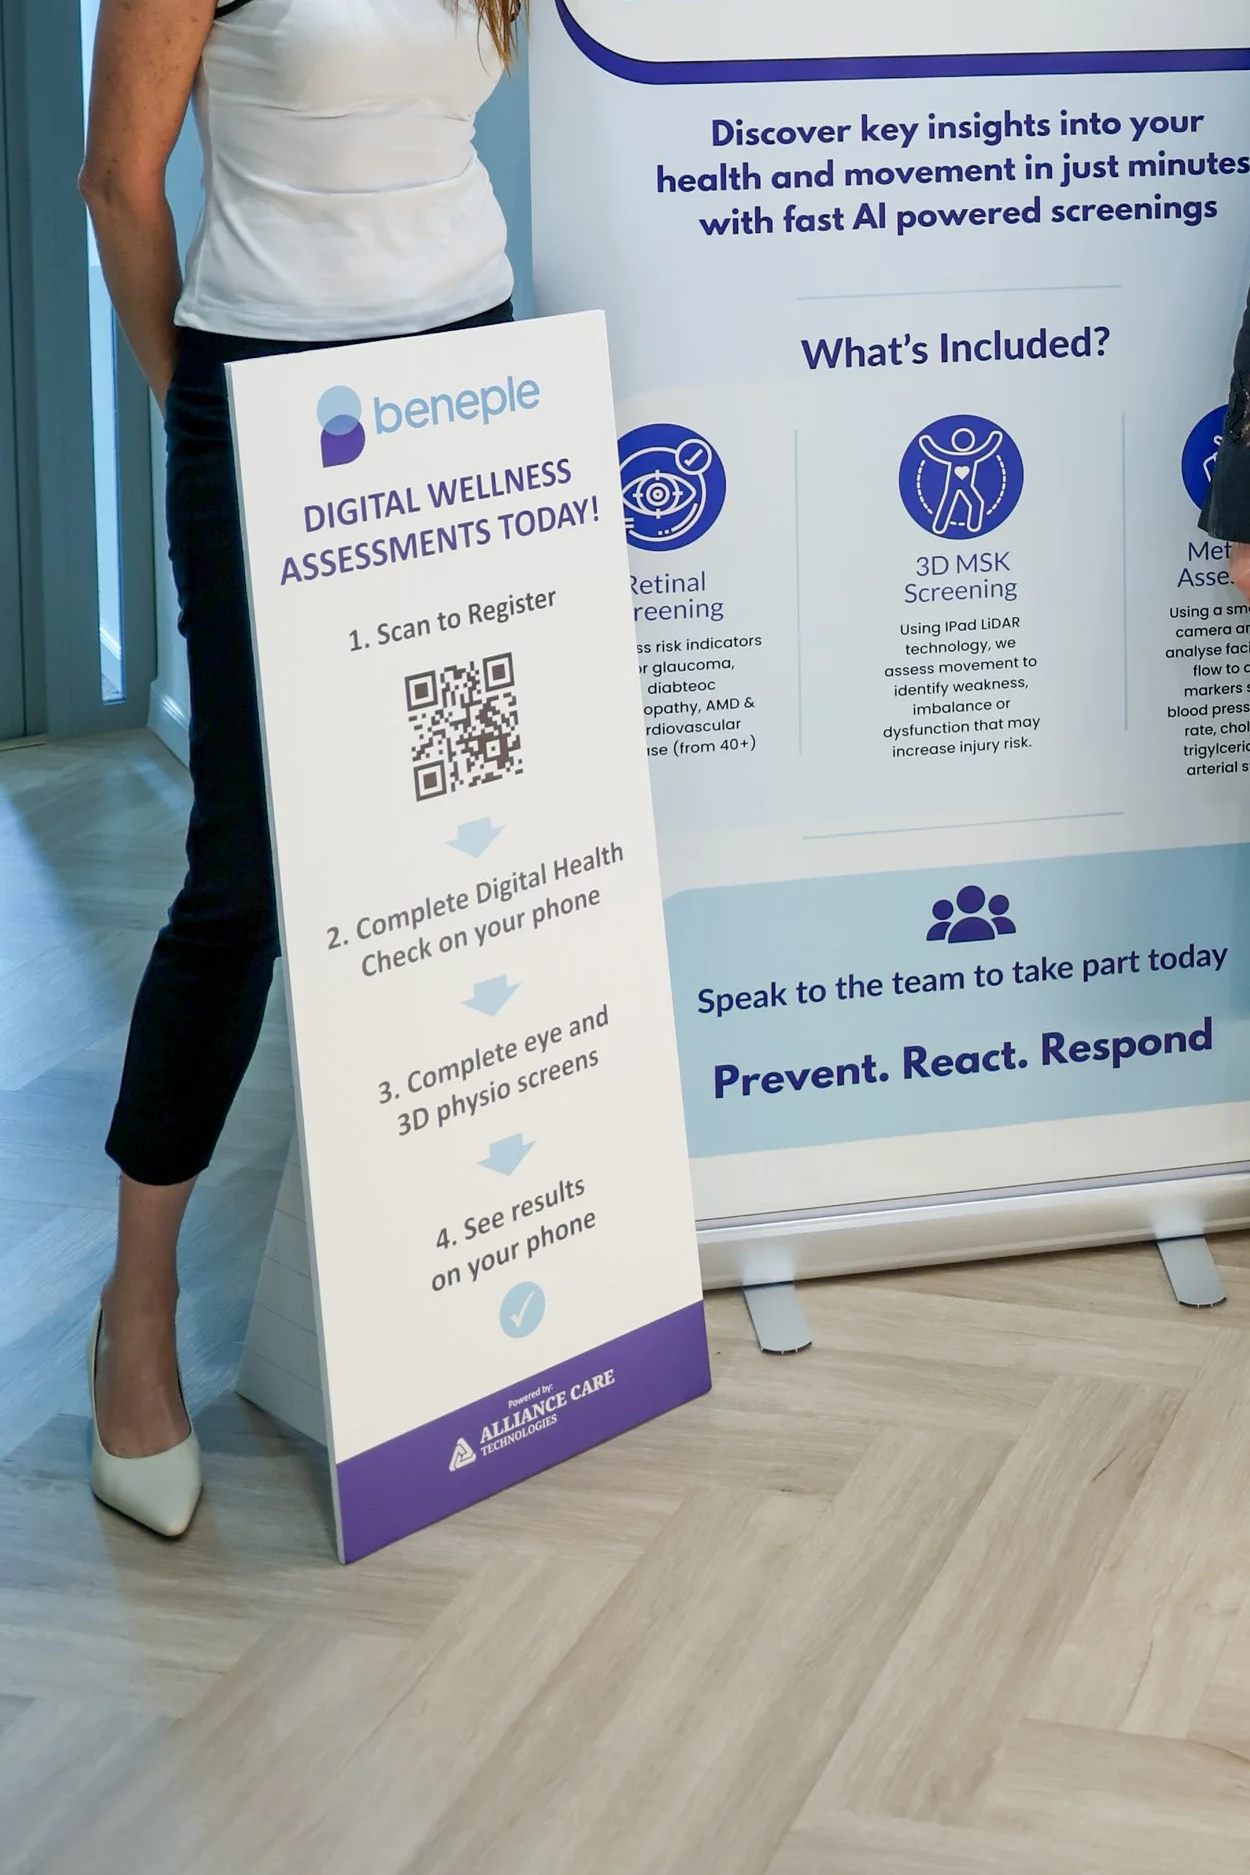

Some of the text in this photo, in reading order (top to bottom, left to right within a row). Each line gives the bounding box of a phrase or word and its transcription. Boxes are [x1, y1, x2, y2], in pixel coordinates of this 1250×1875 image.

[712, 109, 1205, 148] Discover key insights into your
[657, 150, 1250, 193] health and movement in just minutes
[698, 193, 1218, 236] with fast AI powered screenings
[941, 326, 1110, 363] Included?
[373, 375, 540, 435] beneple
[304, 458, 571, 533] DIGITAL WELLNESS
[280, 495, 599, 586] ASSESSMENTS TODAY!
[916, 551, 1010, 577] 3D MSK
[904, 578, 1017, 603] Screening
[349, 590, 556, 652] 1. Scan to Register
[634, 599, 724, 622] reening
[1170, 605, 1209, 621] Using
[1213, 606, 1222, 616] a
[900, 622, 941, 637] Using
[981, 616, 1020, 630] LiDAR
[1176, 625, 1232, 638] camera
[656, 640, 682, 653] risk
[686, 636, 762, 651] indicators
[905, 639, 1016, 655] technology, we
[1165, 645, 1222, 660] analyse
[652, 659, 735, 678] glaucoma,
[884, 656, 1037, 677] assess movement to
[1193, 664, 1223, 677] flow
[1226, 663, 1240, 674] to
[647, 681, 716, 695] diabteoc
[894, 678, 1028, 697] identify weakness,
[1184, 683, 1243, 697] markers
[643, 696, 755, 719] opathy, AMD &
[913, 700, 1011, 716] imbalance or
[1167, 704, 1208, 718] blood
[646, 719, 741, 736] rdiovascular
[883, 718, 1040, 741] dysfunction that may
[1185, 725, 1217, 737] rate,
[673, 740, 715, 757] (from
[720, 734, 756, 752] 40+)
[892, 736, 1032, 757] increase injury risk.
[1186, 761, 1238, 776] arterial
[327, 842, 623, 950] 2. Complete Digital Health
[362, 889, 600, 977] Check on your phone
[698, 943, 1228, 1018] Speak to the team to take part today
[378, 1003, 608, 1104] 3. Complete eye and
[714, 1016, 1212, 1099] Prevent. React. Respond
[397, 1050, 599, 1136] 3D physio screens
[436, 1179, 585, 1249] 4. See results
[432, 1212, 596, 1292] on your phone
[480, 1369, 615, 1444] ALLIANCE CARE
[508, 1383, 554, 1409] Powered by:
[480, 1413, 558, 1456] TECHNOLOGIES
